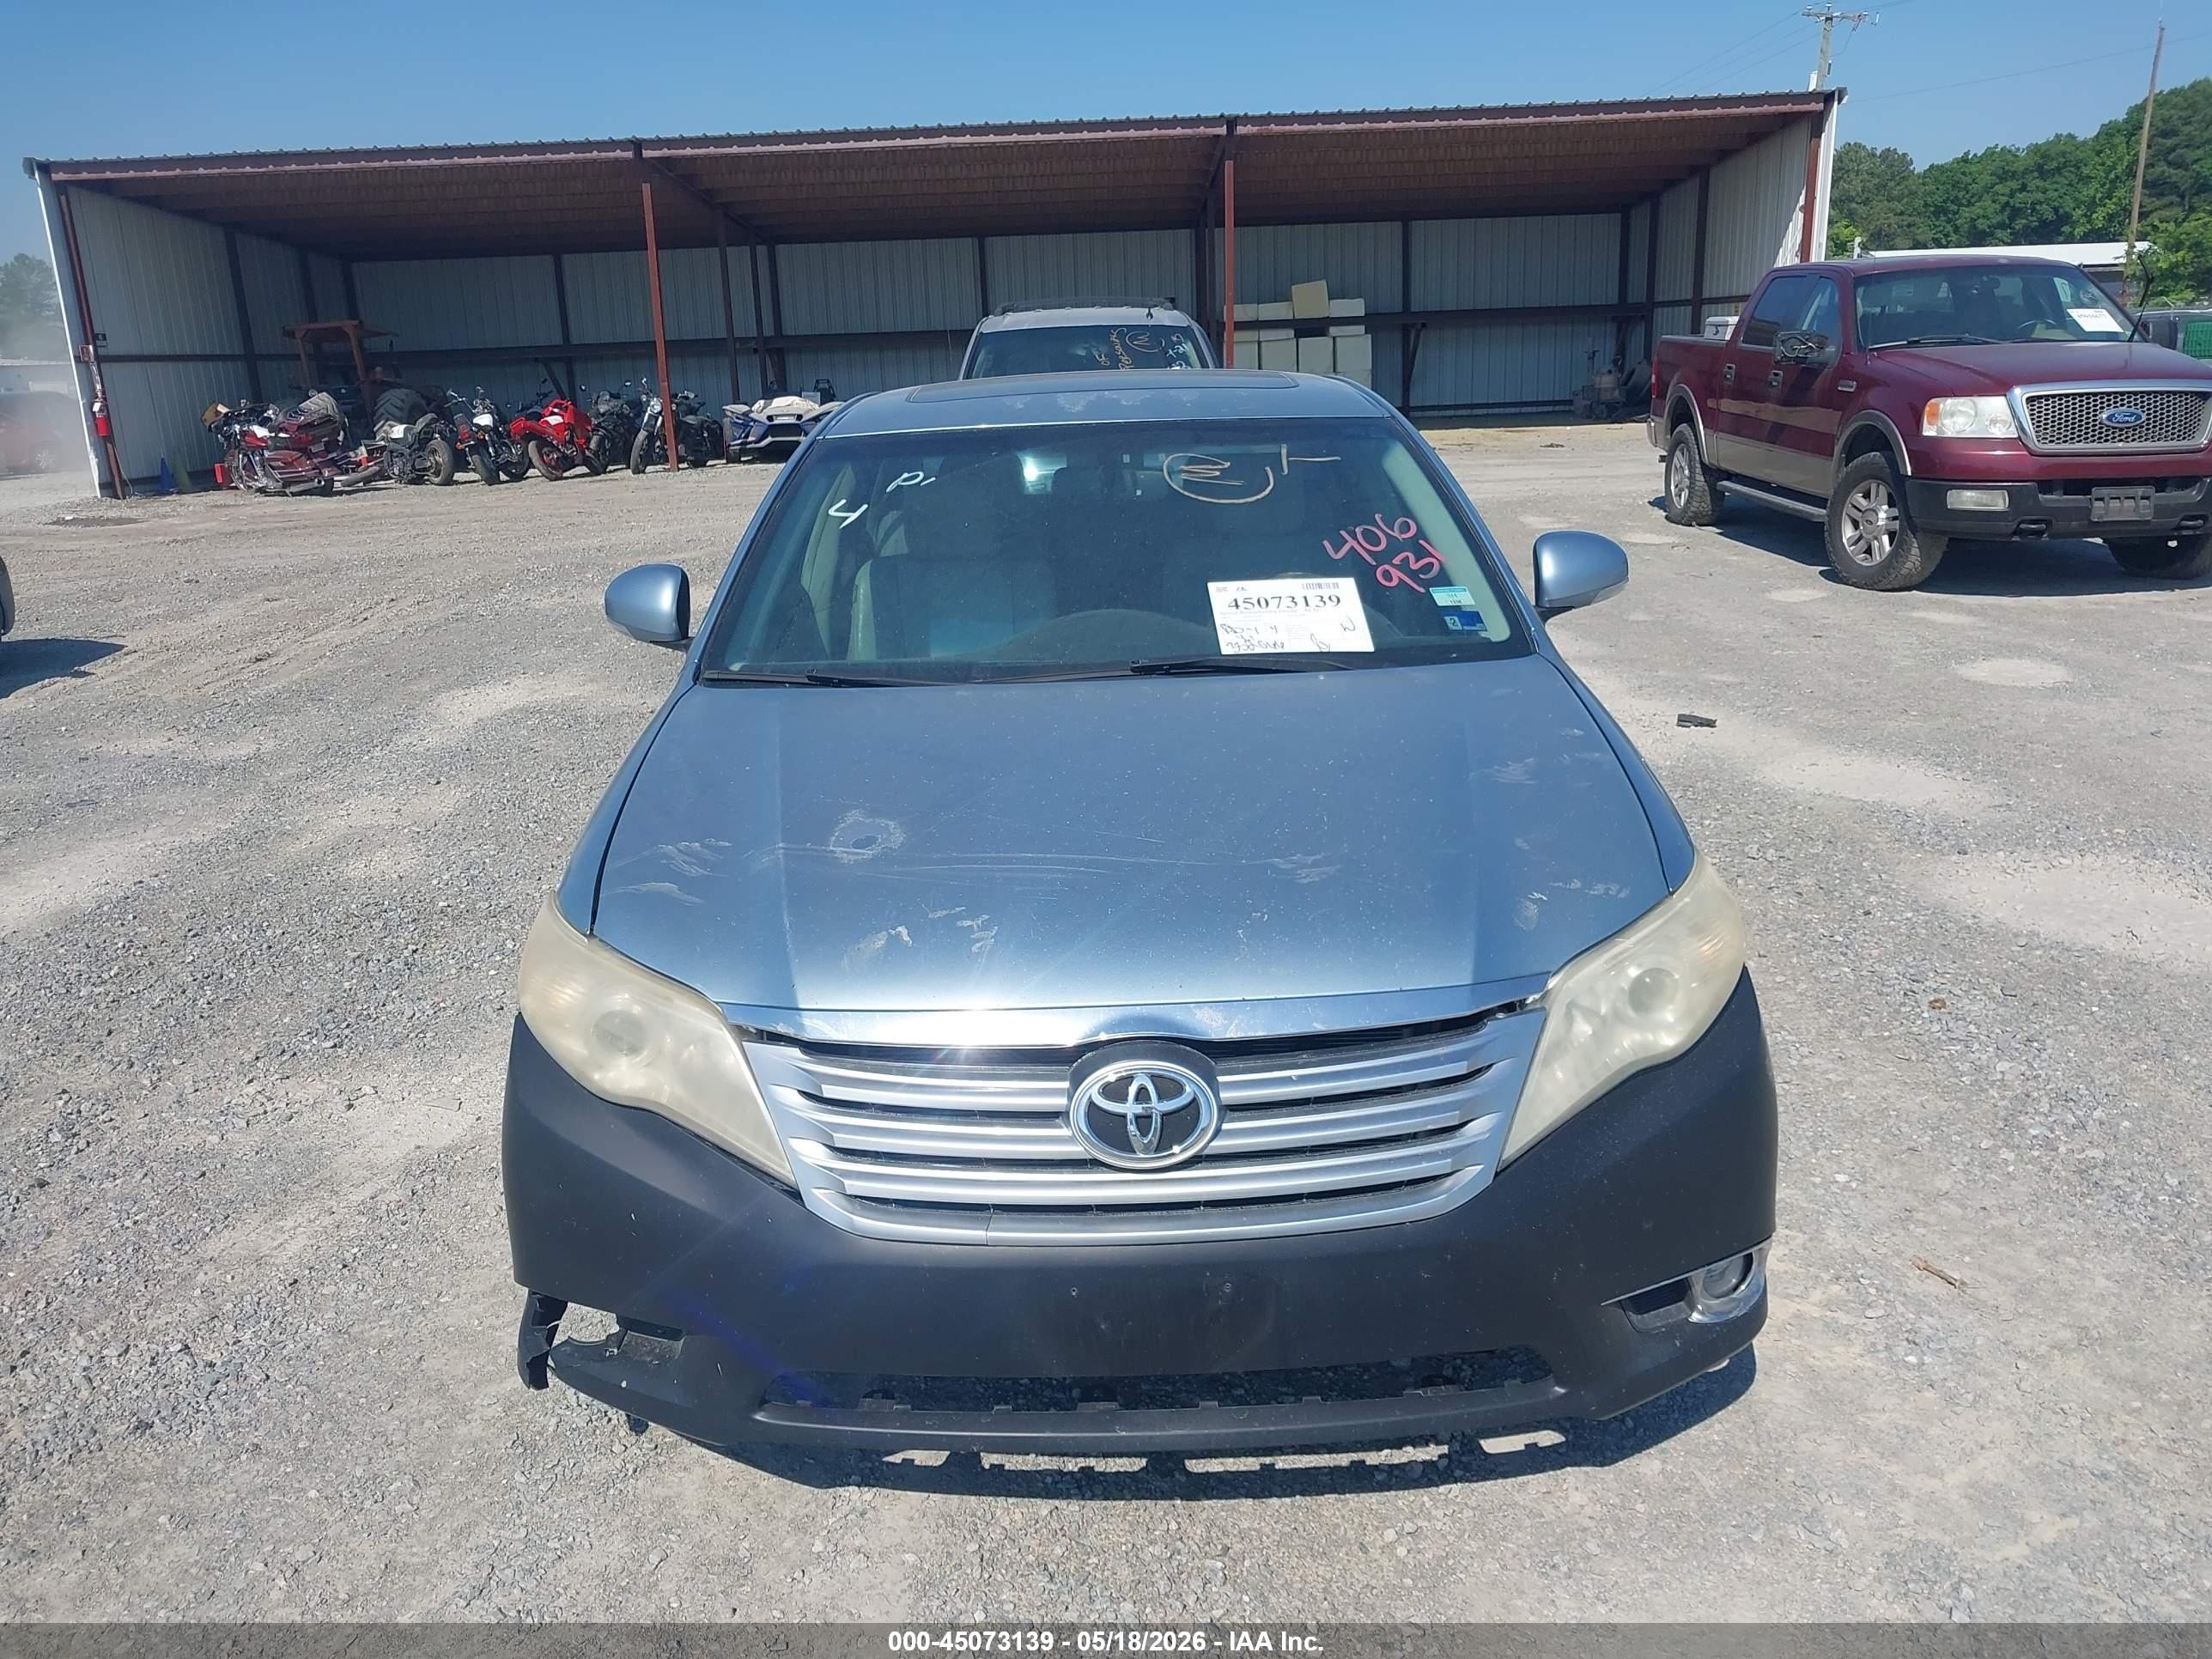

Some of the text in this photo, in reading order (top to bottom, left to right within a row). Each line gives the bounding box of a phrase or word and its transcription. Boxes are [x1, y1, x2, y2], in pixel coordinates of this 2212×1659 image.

[2112, 412, 2136, 422] Ford
[1322, 513, 1418, 566] 406
[1375, 538, 1445, 592] 931
[1227, 593, 1341, 611] 45073139
